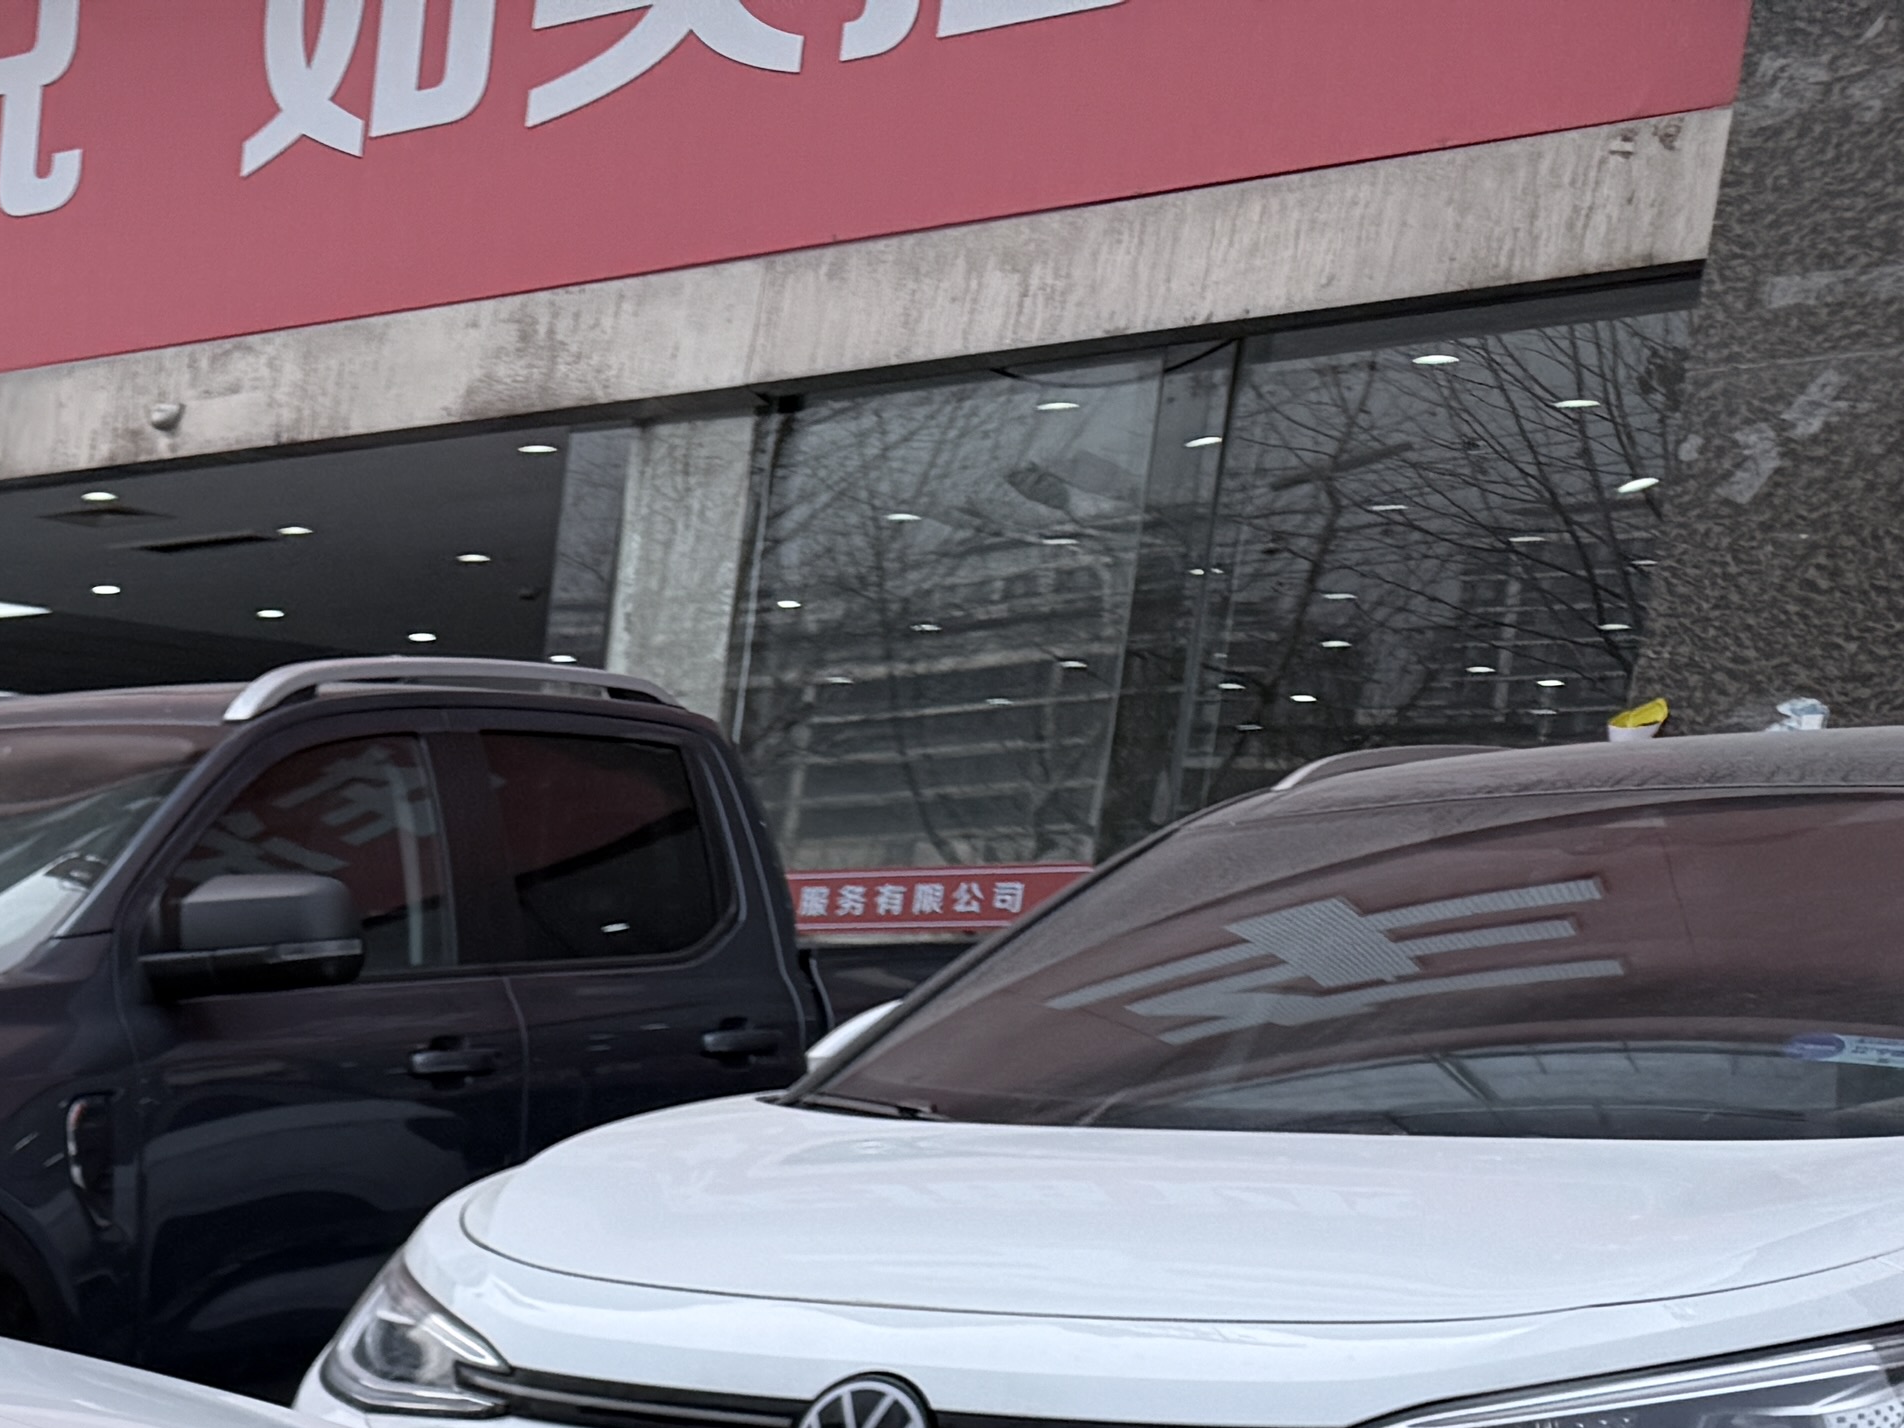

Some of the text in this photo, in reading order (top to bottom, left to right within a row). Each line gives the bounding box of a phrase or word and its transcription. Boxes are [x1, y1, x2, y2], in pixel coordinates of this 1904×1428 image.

[798, 881, 1025, 917] 服务有限公司
